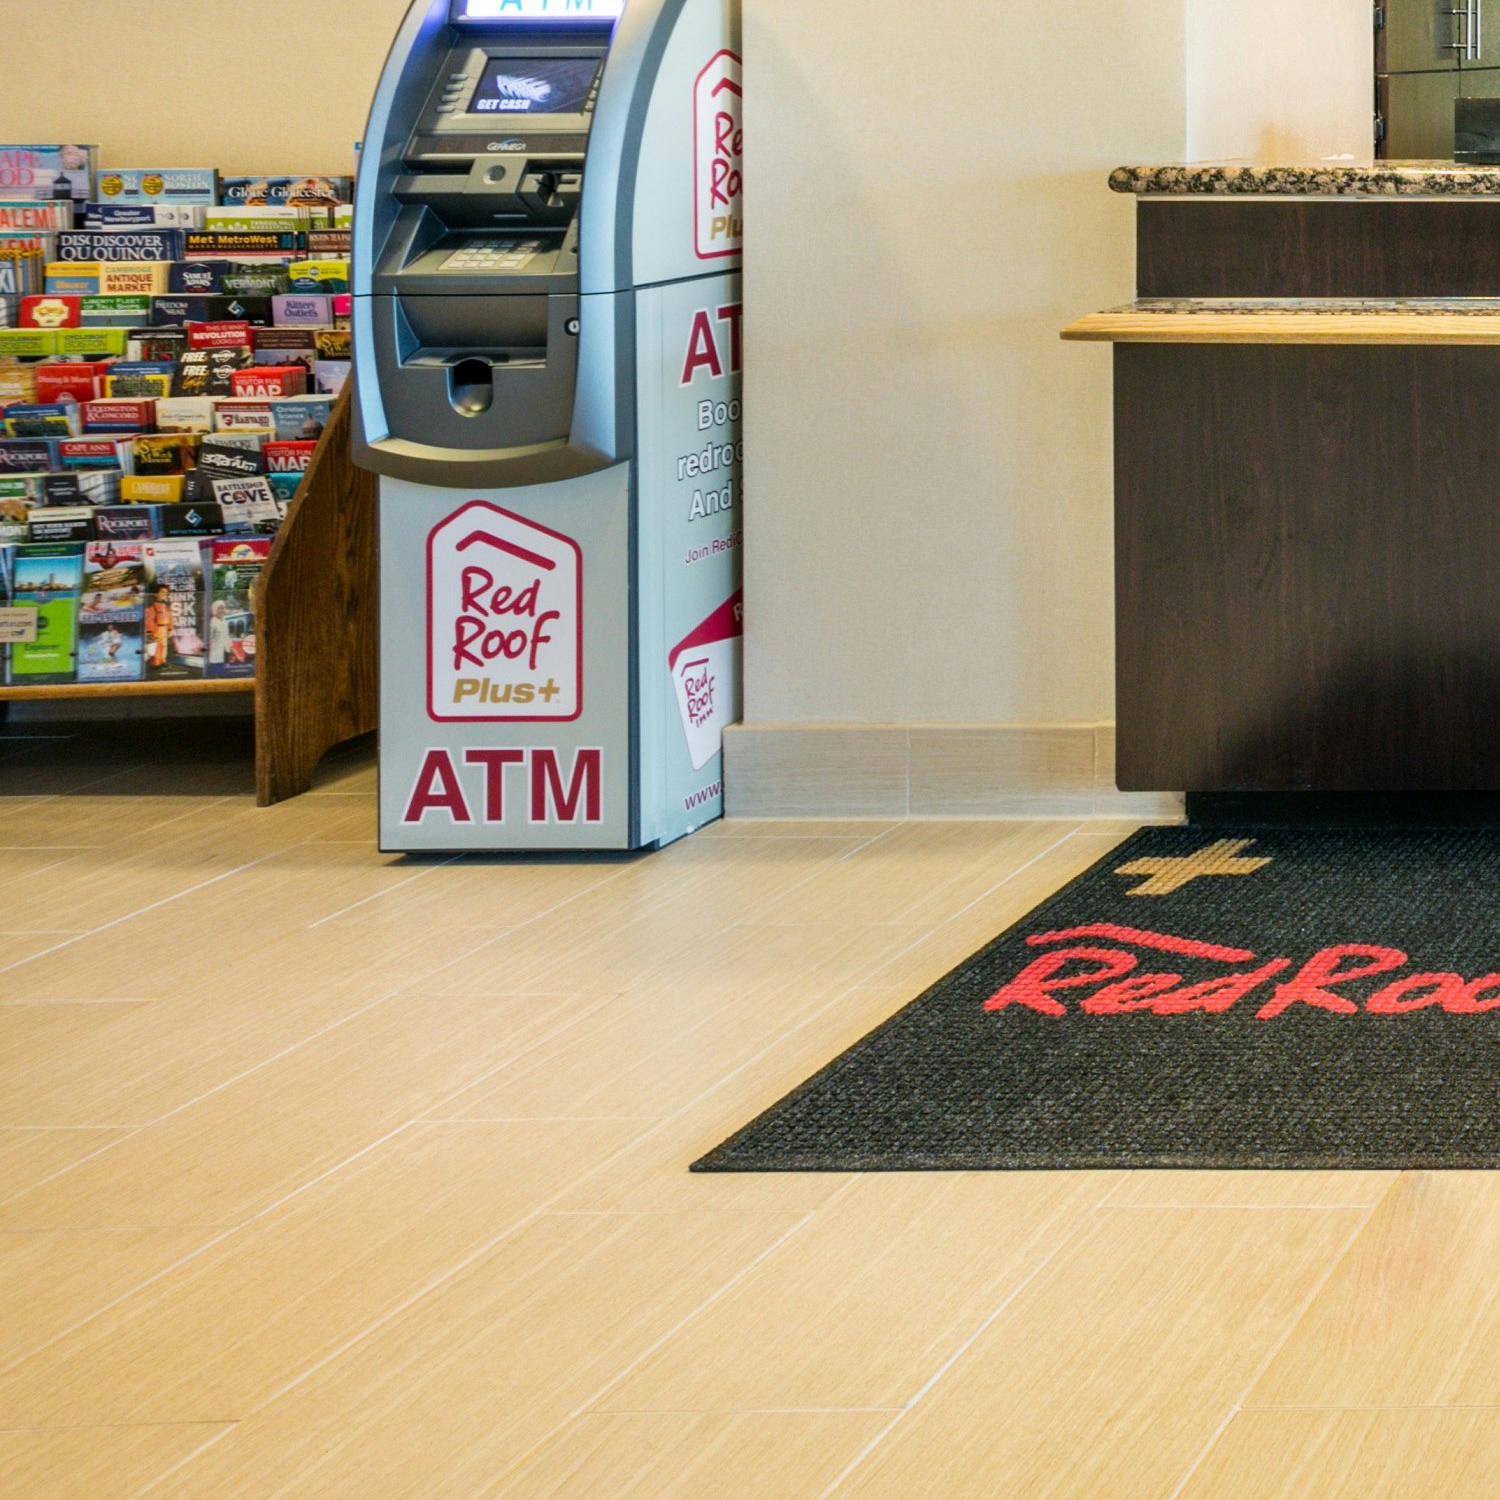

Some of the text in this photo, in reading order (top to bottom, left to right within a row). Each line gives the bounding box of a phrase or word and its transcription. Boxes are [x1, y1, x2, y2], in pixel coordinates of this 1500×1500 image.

[476, 99, 531, 111] GET CASH
[271, 186, 335, 198] Gloucester
[92, 235, 163, 246] DISCOVER
[218, 235, 278, 244] MetroWest
[92, 247, 164, 261] QUINCY
[105, 274, 152, 283] ANTIQUE
[225, 278, 278, 288] VERMONT
[107, 283, 152, 292] MARKET
[285, 300, 316, 311] Kittery
[283, 308, 319, 318] Outlets
[193, 331, 247, 340] REVOLUTION
[181, 351, 206, 363] FREE
[183, 364, 207, 376] FREE
[236, 385, 282, 397] MAP
[86, 404, 138, 413] LEXINGTON
[64, 443, 88, 452] CAPE
[267, 449, 296, 457] VISITOR
[268, 457, 312, 471] MAP
[216, 481, 264, 492] BATTLESHIP
[220, 488, 270, 506] COVE
[688, 479, 733, 522] And
[97, 515, 149, 533] ROCKPORT
[685, 545, 709, 564] Join
[157, 577, 196, 585] DESIGN
[460, 565, 541, 618] Red
[452, 610, 560, 670] Roof
[684, 668, 708, 699] Red
[452, 678, 560, 704] Plus+
[687, 676, 716, 723] Roof
[402, 748, 602, 824] ATM
